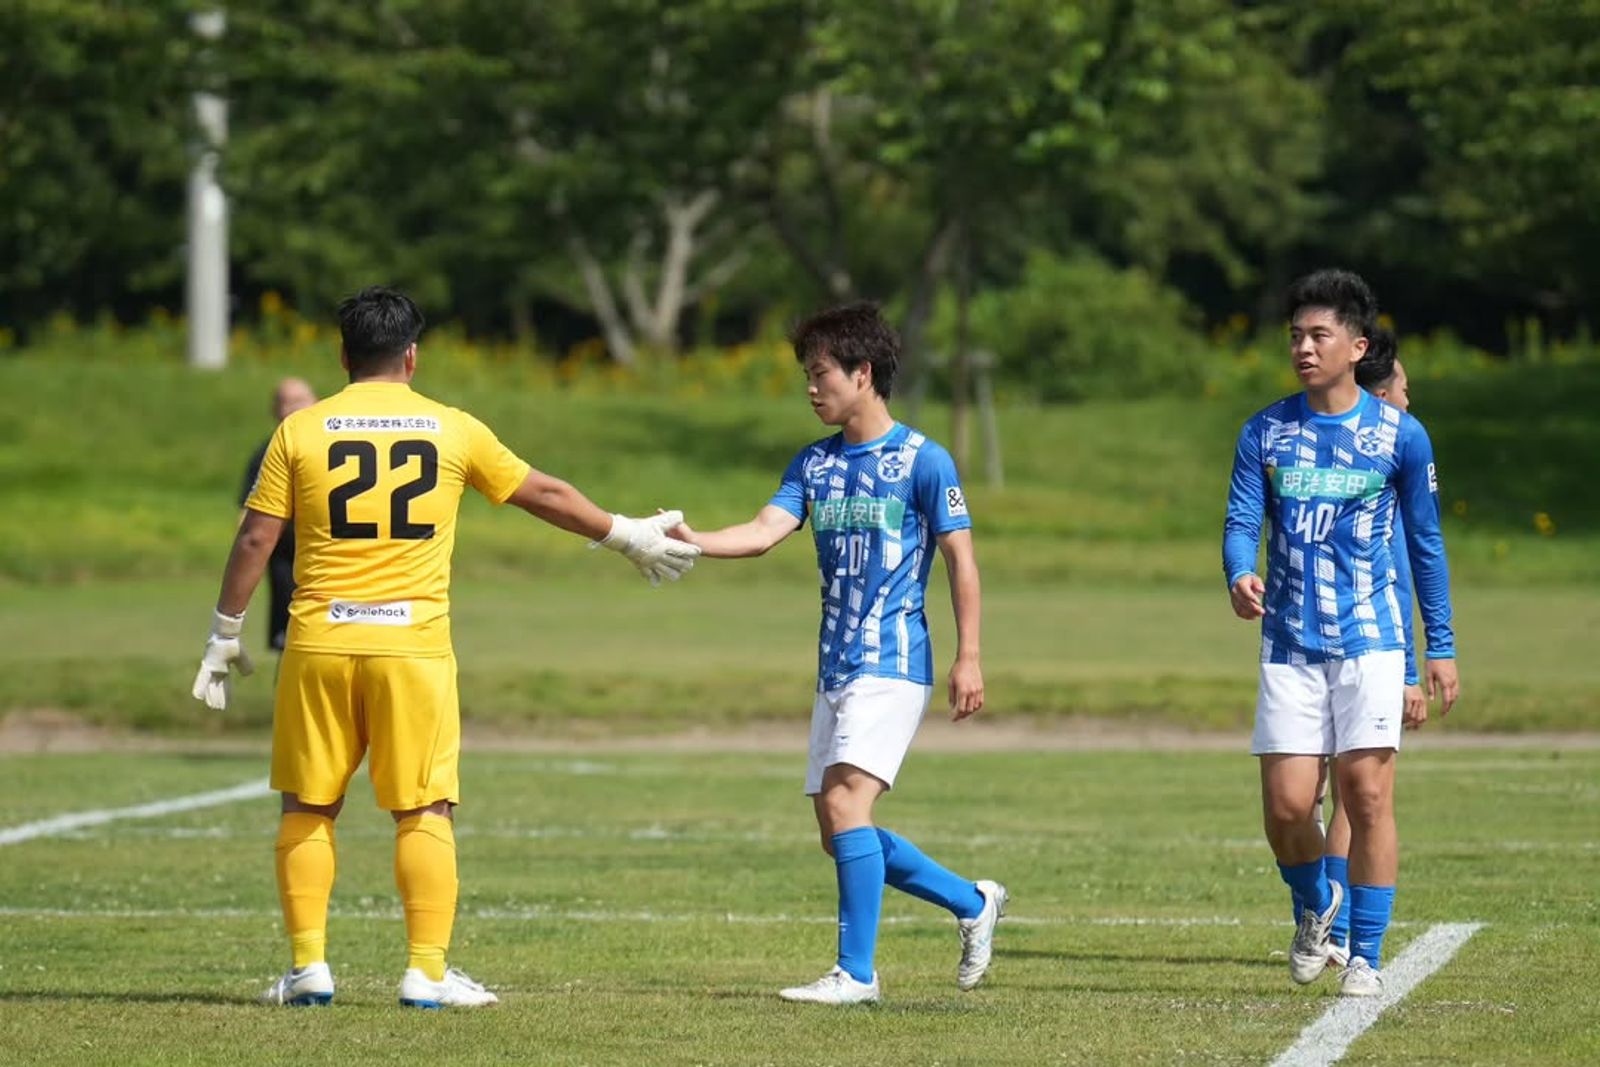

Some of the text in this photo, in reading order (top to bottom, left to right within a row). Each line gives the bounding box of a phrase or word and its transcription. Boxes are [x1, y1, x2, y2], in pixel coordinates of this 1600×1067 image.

[328, 439, 438, 539] 22
[1282, 472, 1367, 494] 明治安田
[820, 502, 885, 524] 明治安田
[1296, 503, 1335, 543] 40
[836, 535, 864, 576] 20
